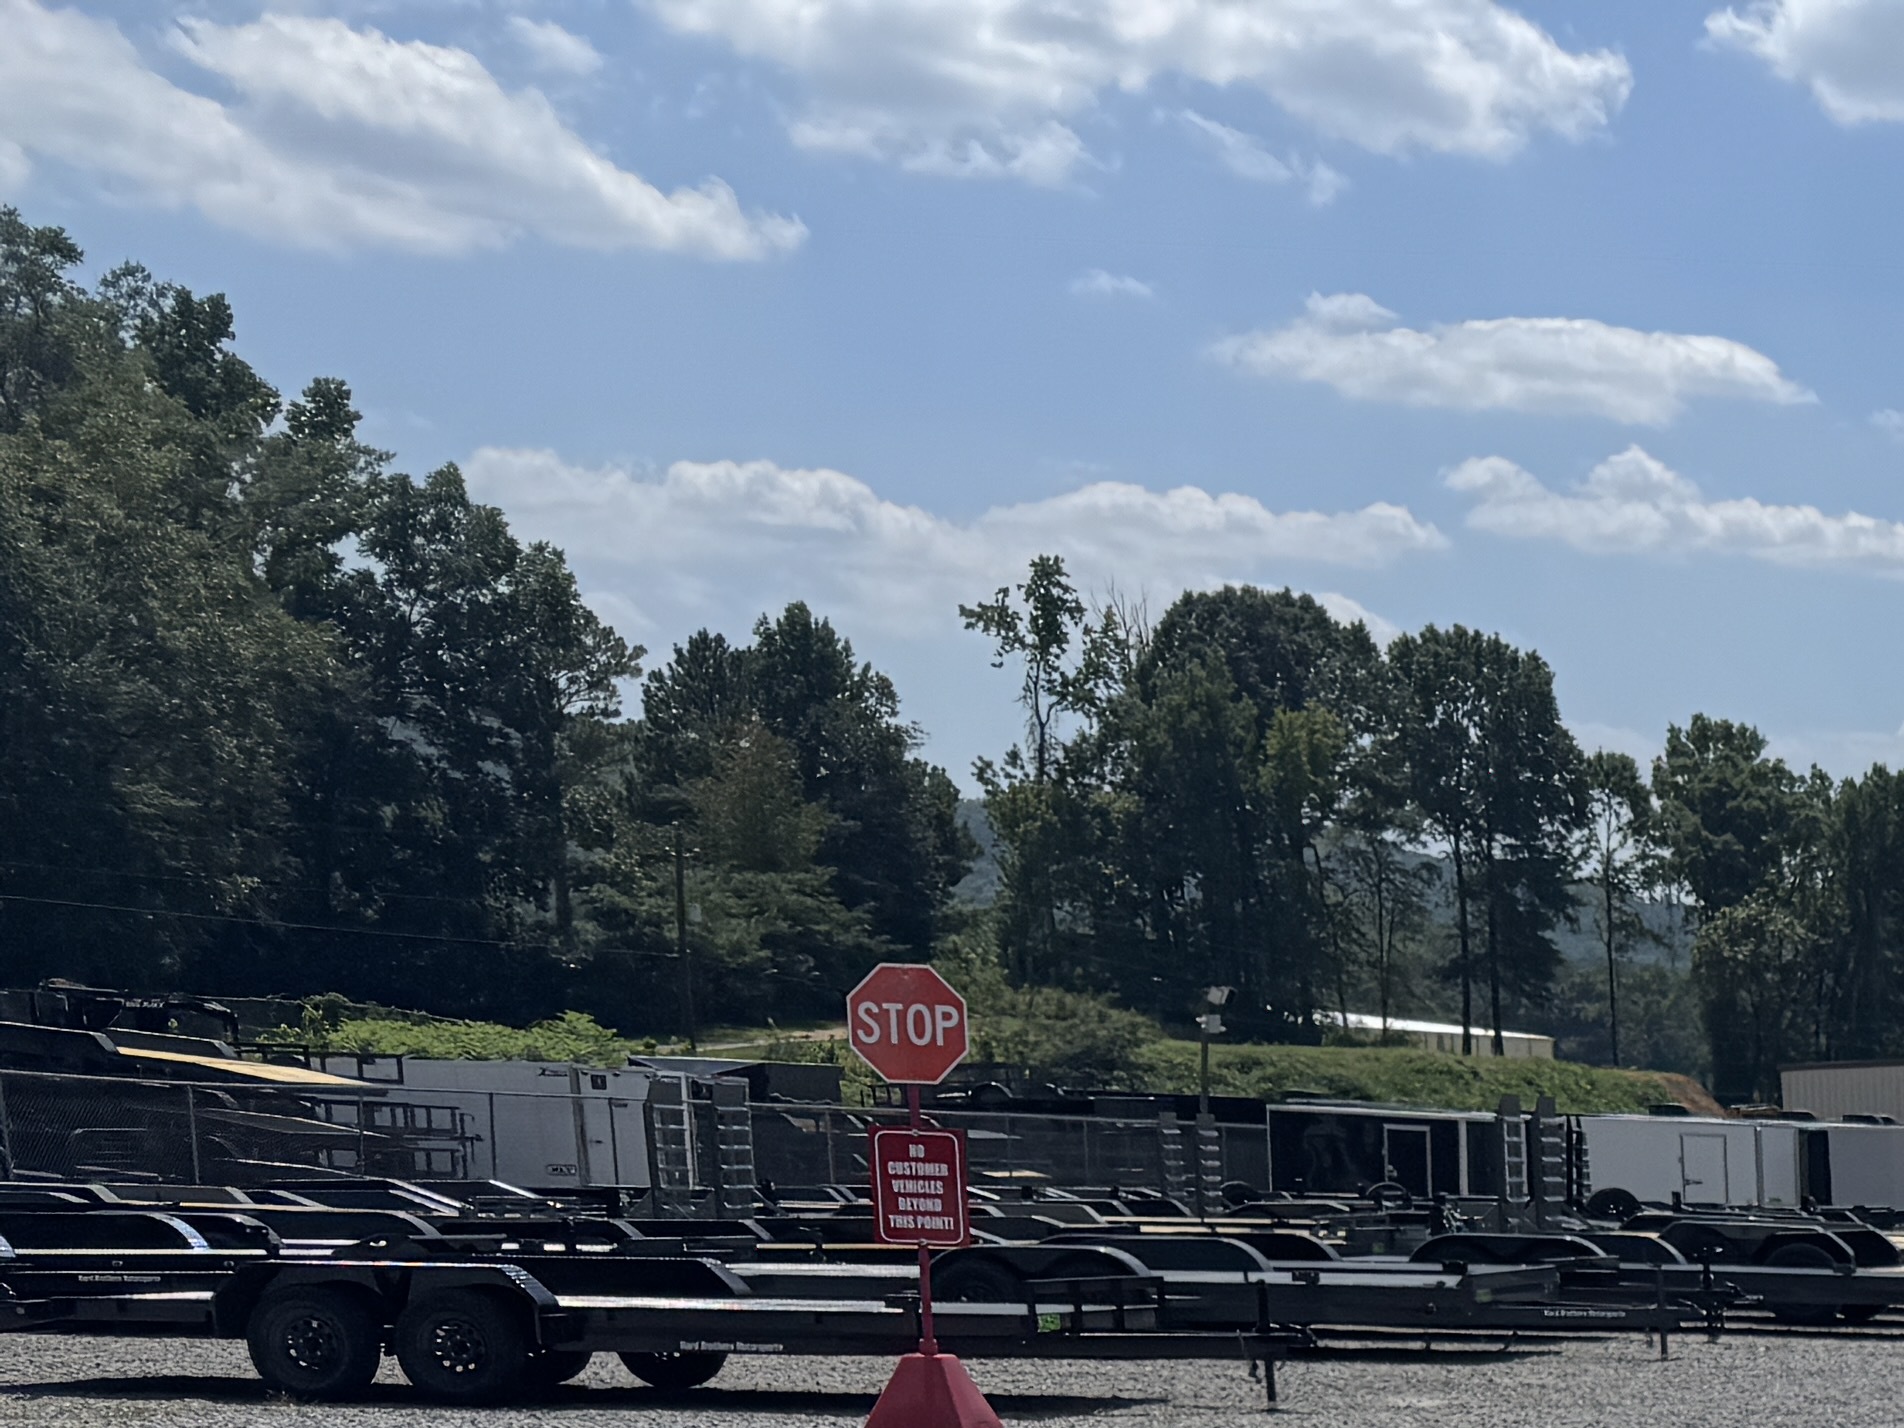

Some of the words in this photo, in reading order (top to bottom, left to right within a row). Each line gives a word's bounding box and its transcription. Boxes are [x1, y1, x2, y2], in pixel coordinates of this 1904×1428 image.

[857, 1001, 960, 1047] STOP
[908, 1144, 926, 1159] NO
[887, 1161, 949, 1177] CUSTOMER
[891, 1179, 944, 1195] VEHICLES
[898, 1196, 942, 1213] BEYOND
[888, 1214, 915, 1229] THIS
